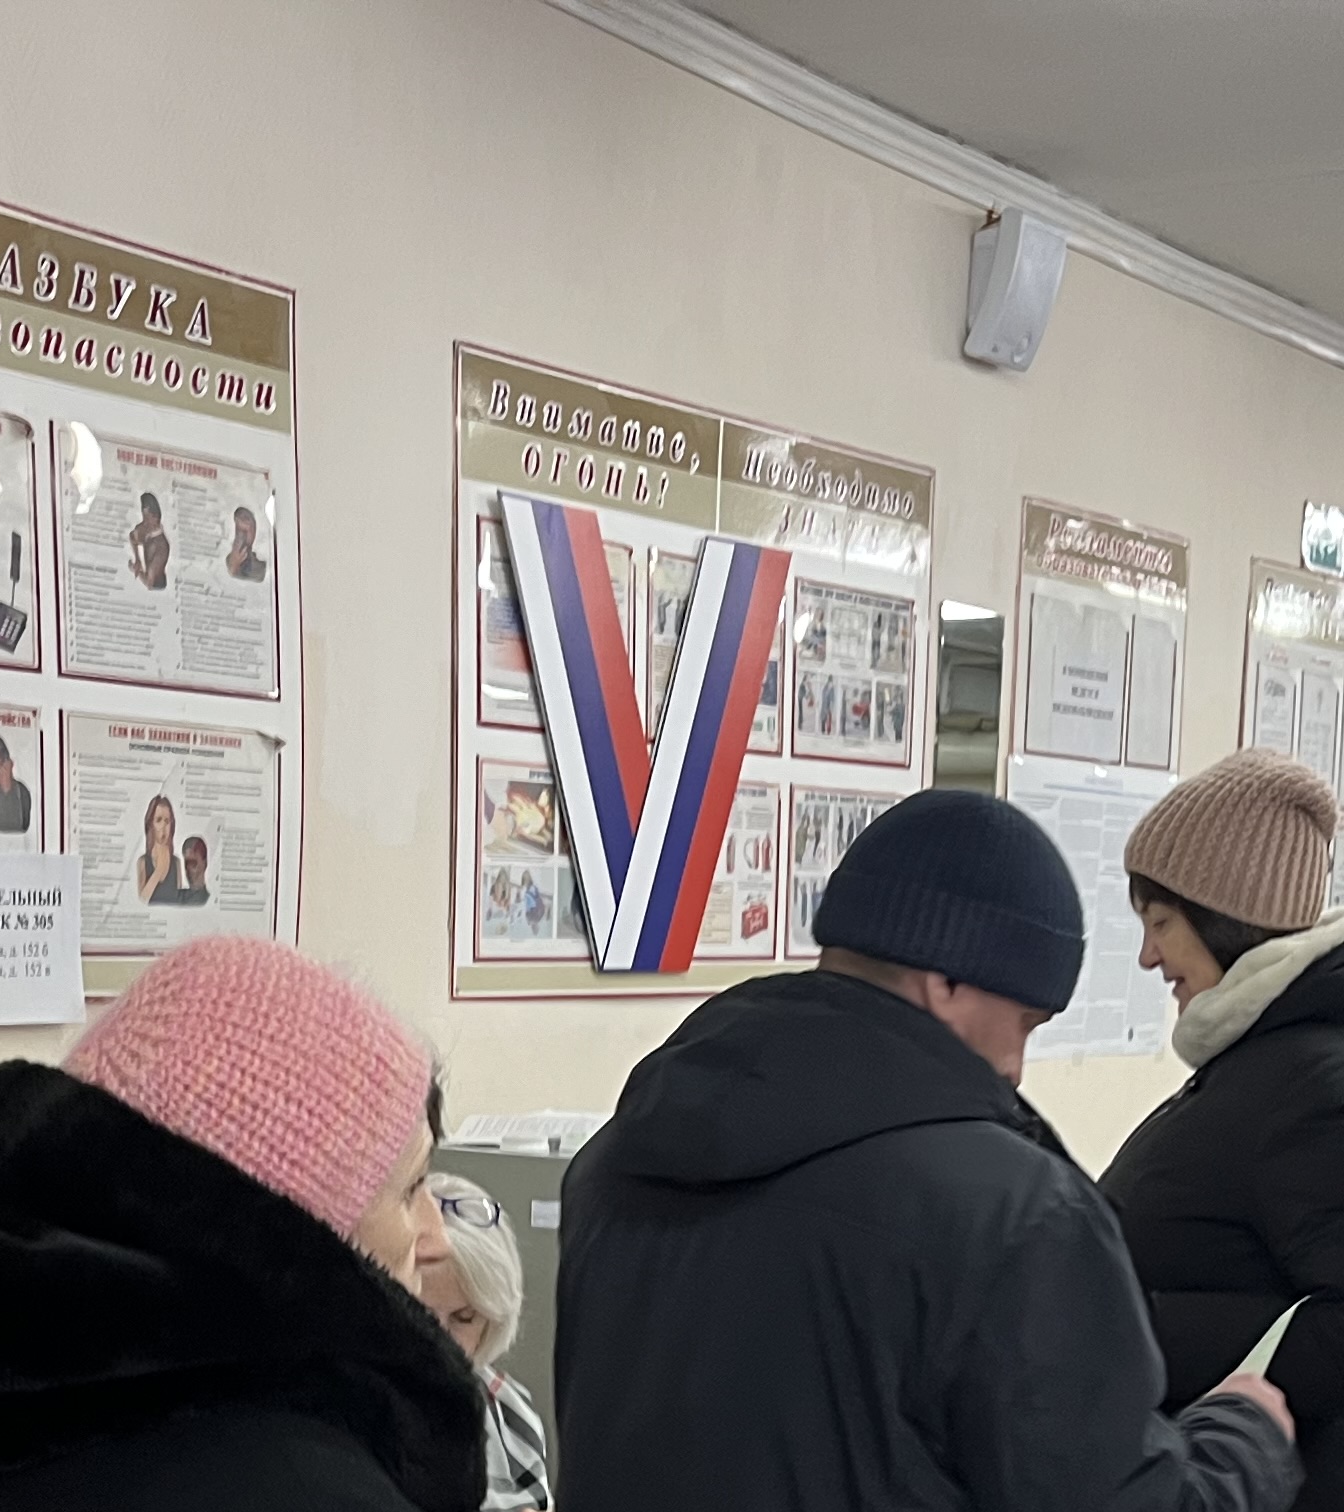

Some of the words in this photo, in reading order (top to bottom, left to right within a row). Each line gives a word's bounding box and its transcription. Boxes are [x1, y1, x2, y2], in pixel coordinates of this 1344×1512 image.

[485, 377, 702, 476] Внимание,
[521, 443, 671, 510] ОГОНЬ!
[741, 443, 916, 520] Необходимо
[13, 914, 30, 930] №
[31, 914, 55, 931] 305
[22, 942, 40, 958] 152
[24, 962, 43, 978] 152
